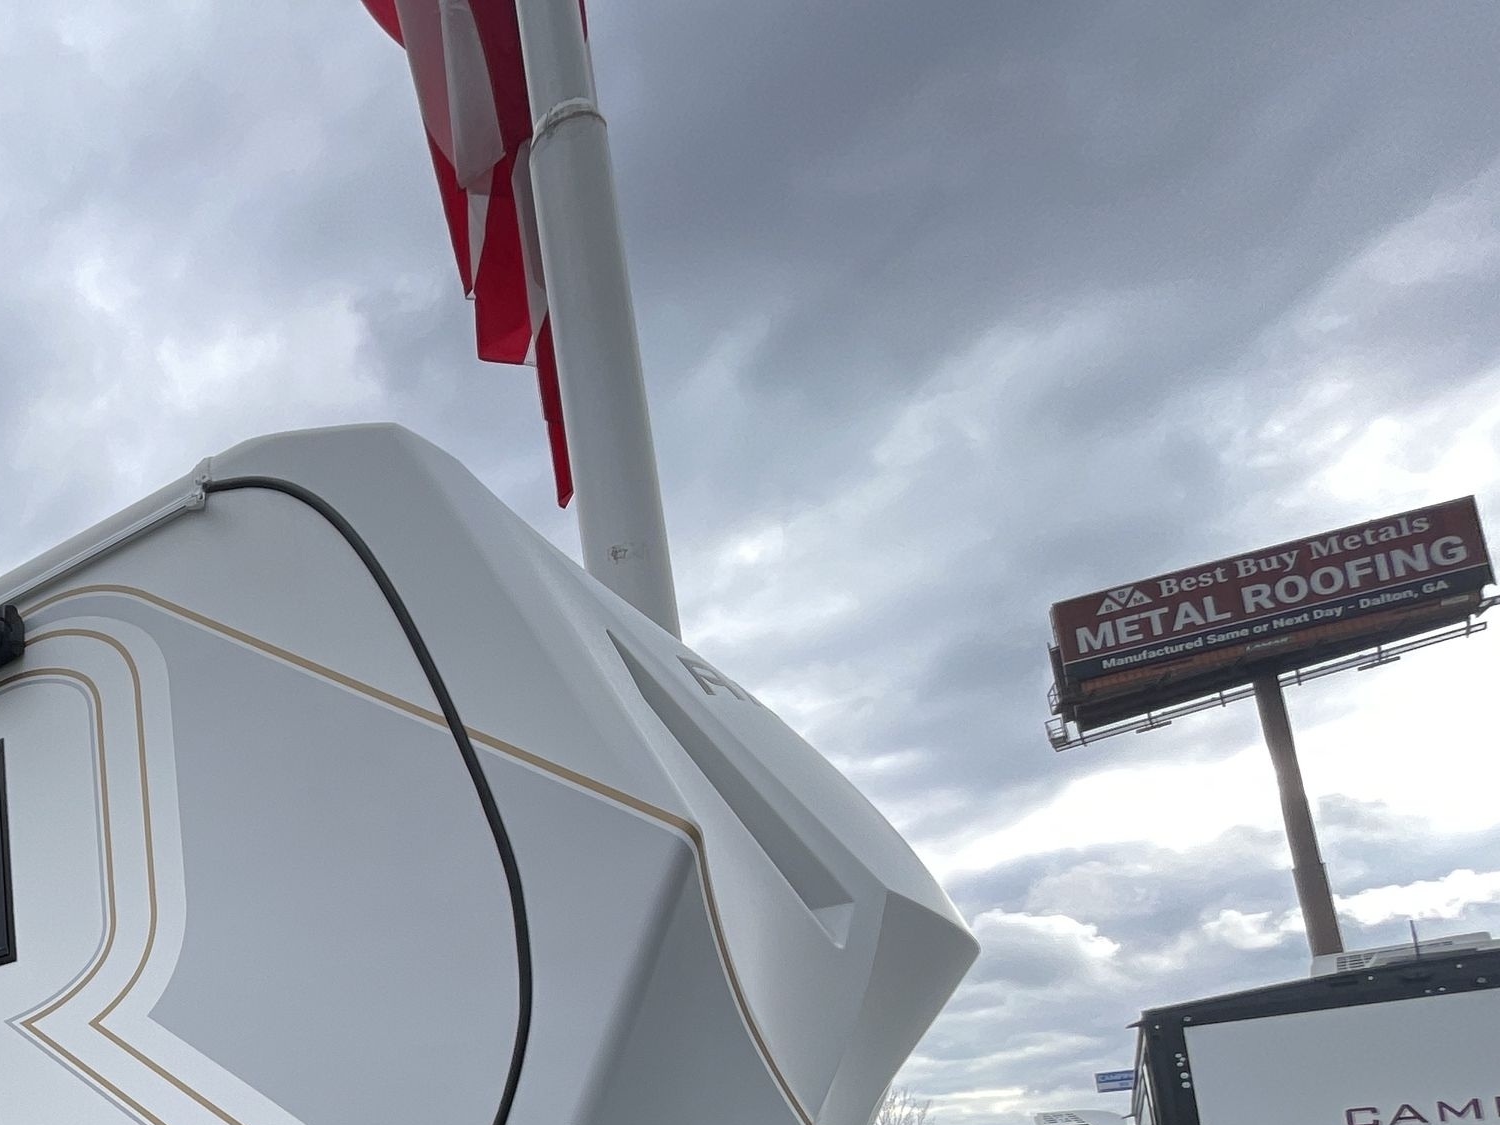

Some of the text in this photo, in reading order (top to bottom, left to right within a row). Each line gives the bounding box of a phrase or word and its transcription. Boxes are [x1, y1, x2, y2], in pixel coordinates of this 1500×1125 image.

[1075, 535, 1468, 654] METAL ROOFING
[1156, 516, 1431, 598] Best Buy Metals
[1102, 636, 1204, 670] Manufactured
[1206, 625, 1250, 645] Same
[1253, 623, 1269, 634] or
[1272, 612, 1310, 631] Next
[1313, 606, 1344, 621] Day
[1422, 579, 1450, 595] GA
